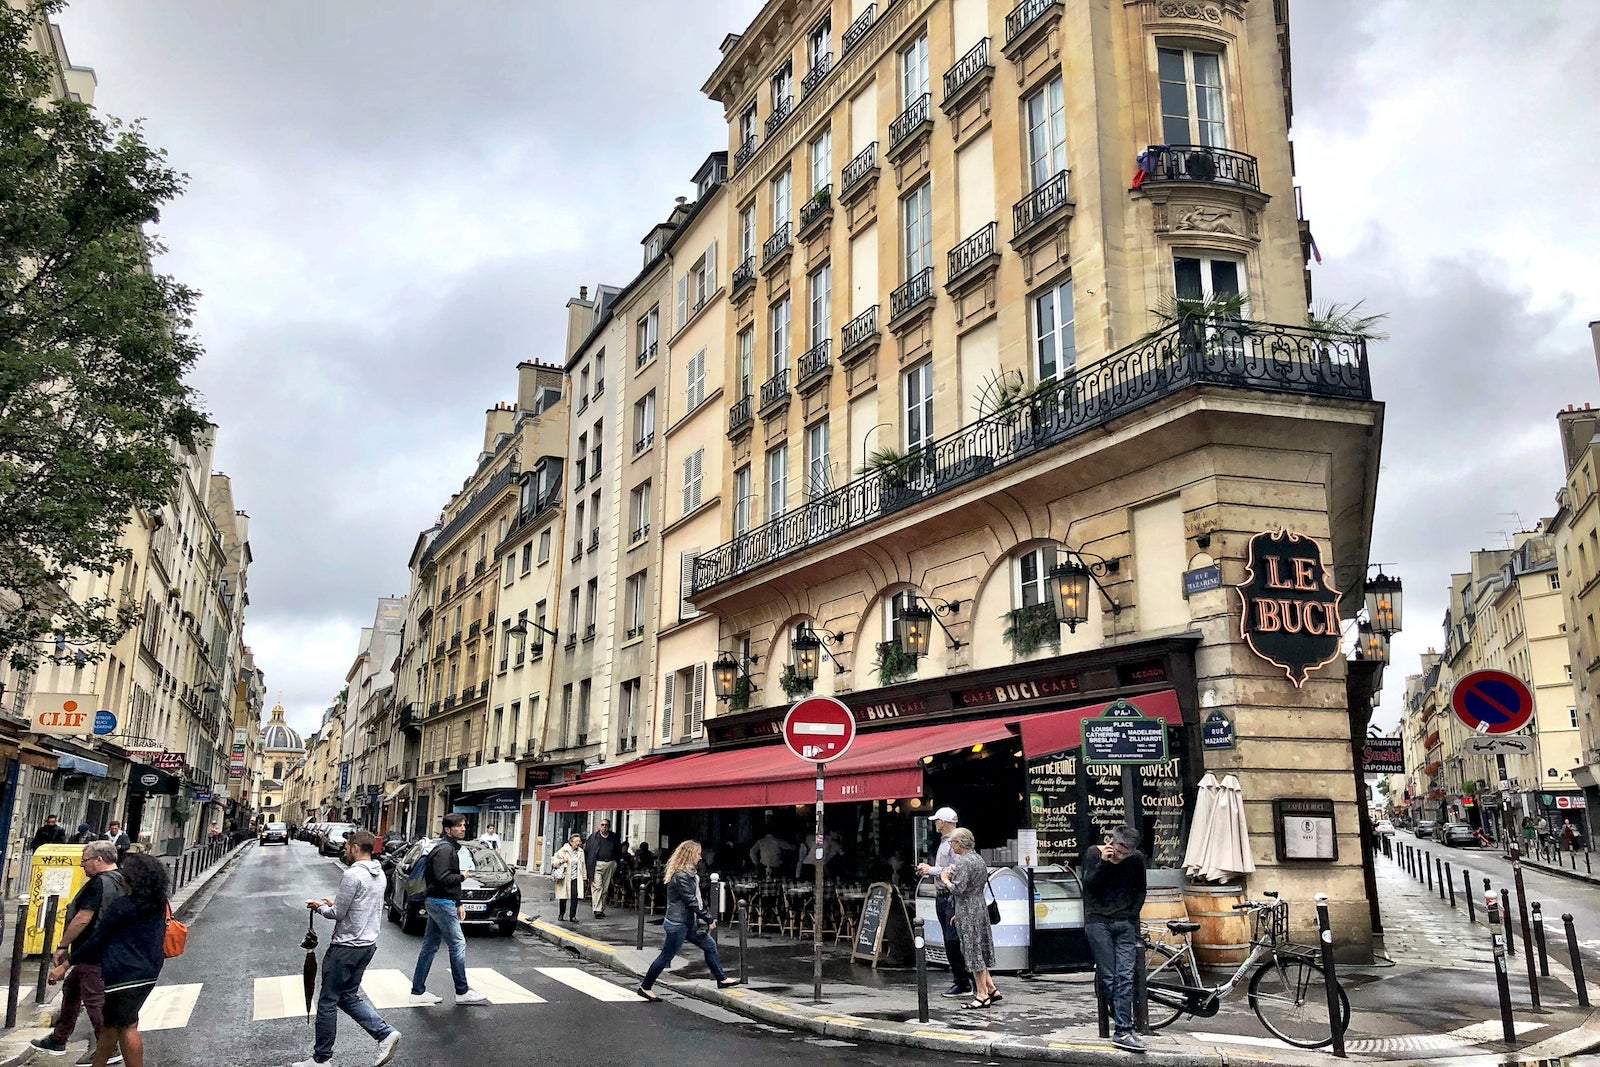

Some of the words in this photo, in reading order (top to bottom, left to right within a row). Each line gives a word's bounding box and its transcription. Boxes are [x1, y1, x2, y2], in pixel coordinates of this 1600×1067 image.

[1194, 571, 1209, 580] RUE
[1265, 555, 1319, 592] LE
[1187, 577, 1218, 589] MAZARINE
[1255, 598, 1337, 636] BUCI
[995, 680, 1040, 703] BUCI
[866, 702, 900, 720] BUCI
[38, 711, 88, 727] CLIF
[1211, 727, 1224, 735] RUE
[1204, 736, 1230, 745] MAZARIN
[152, 753, 183, 763] PIZZA
[1361, 746, 1402, 764] Sushi
[1028, 764, 1045, 775] PETIT
[1086, 764, 1122, 776] CUISIN
[1140, 758, 1180, 777] OUVERT
[841, 784, 858, 795] BUCI
[1087, 794, 1106, 806] PLAT
[1113, 796, 1125, 806] JO
[1141, 793, 1185, 807] COCKTAILS
